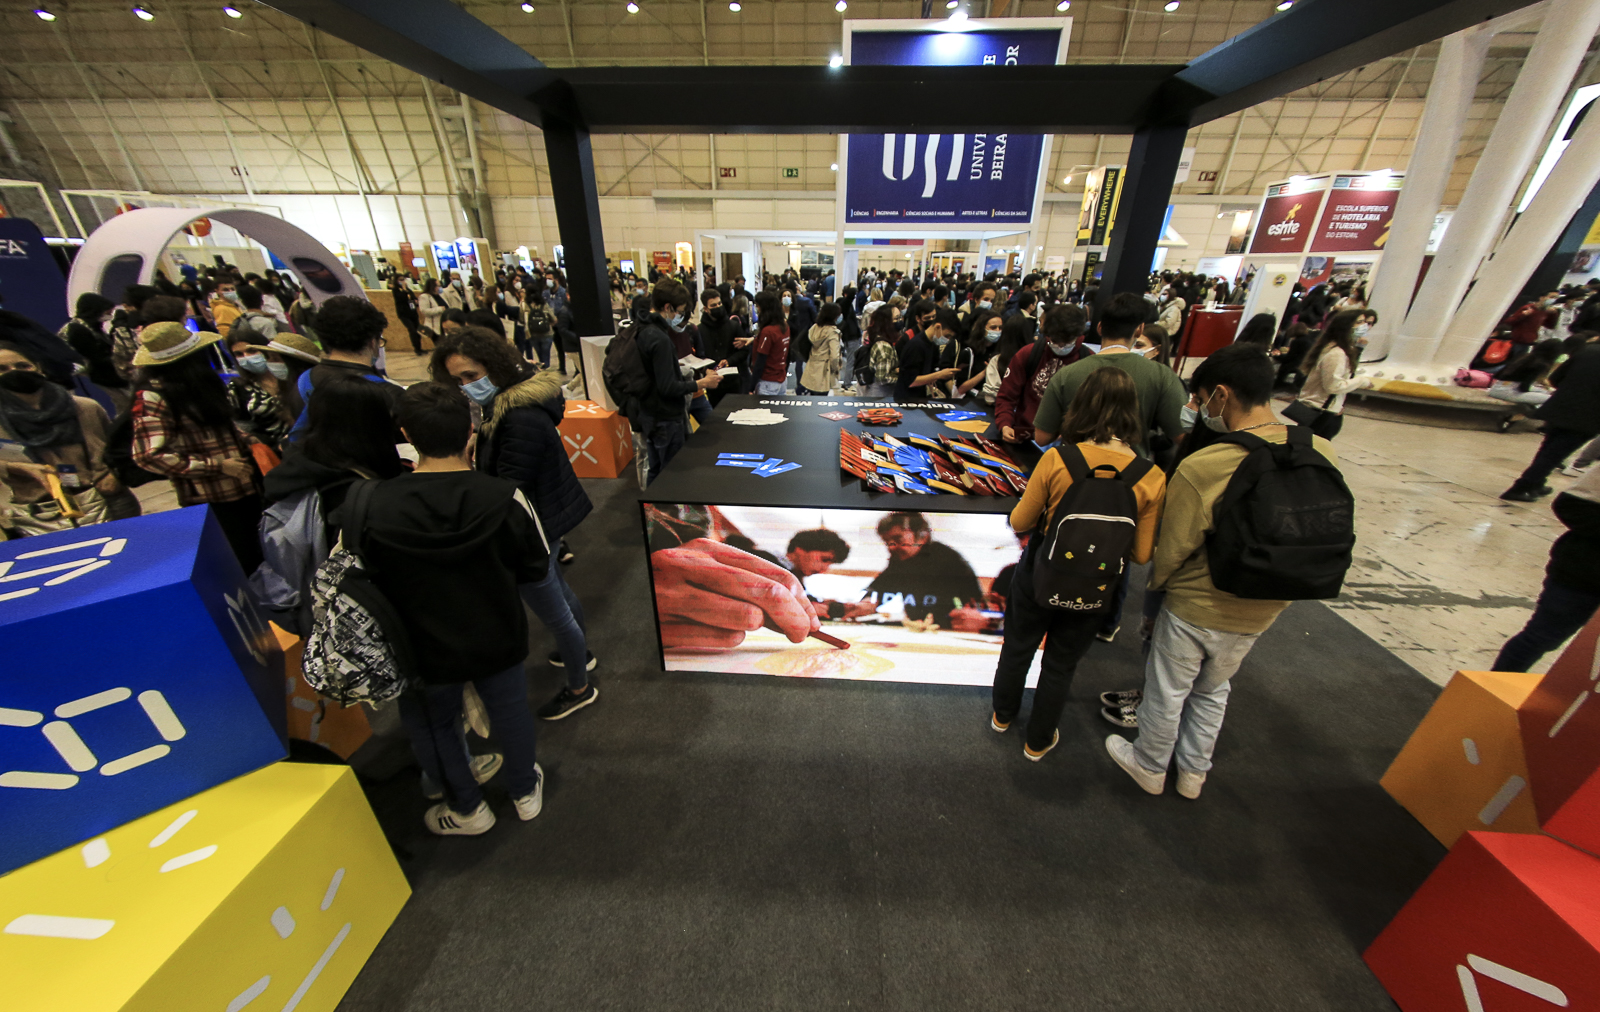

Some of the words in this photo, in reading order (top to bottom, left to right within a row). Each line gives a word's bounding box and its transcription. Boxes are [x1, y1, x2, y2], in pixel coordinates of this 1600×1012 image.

[1097, 170, 1116, 226] EVERYWHERE
[1267, 220, 1300, 236] eshte
[1335, 222, 1368, 230] TURISMO
[844, 402, 956, 410] Universidade
[1049, 598, 1103, 610] adidas
